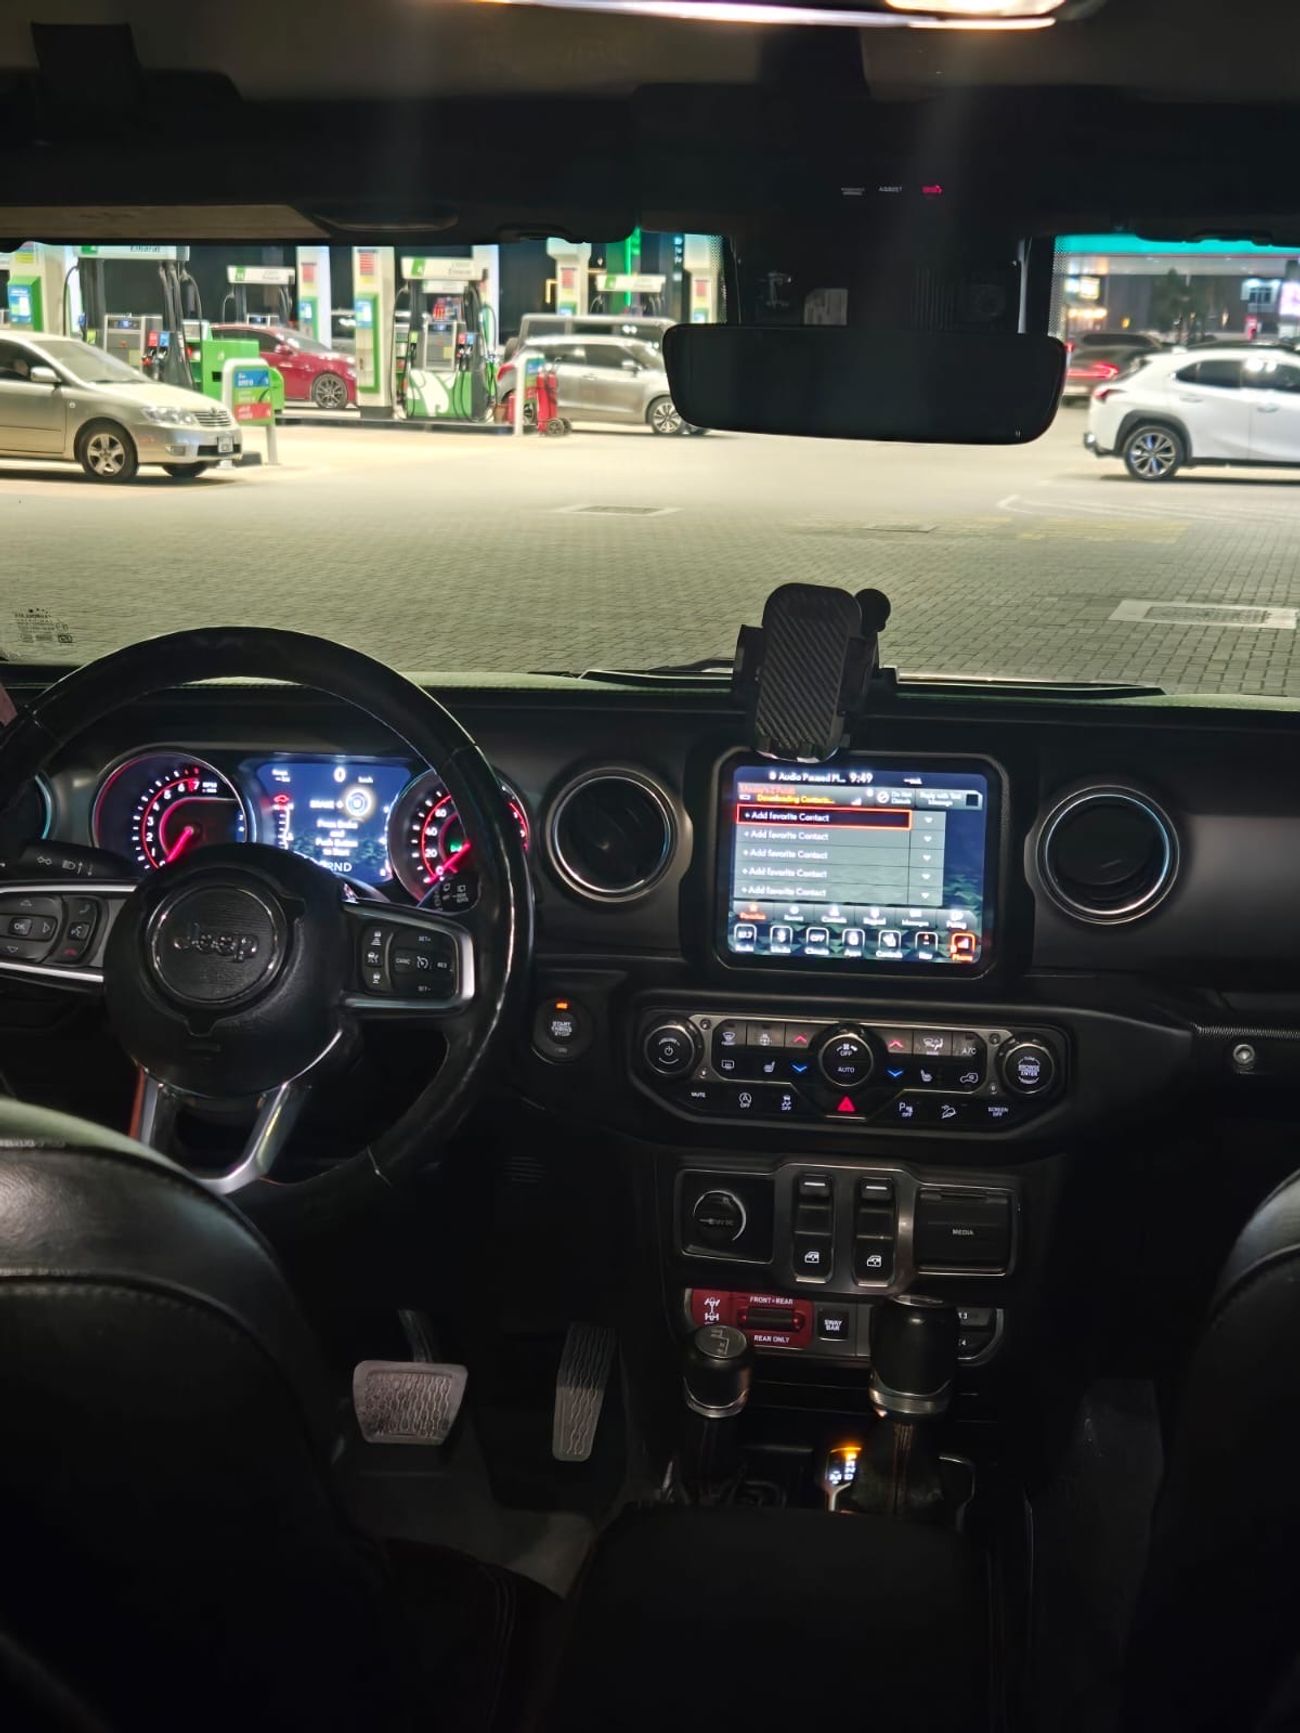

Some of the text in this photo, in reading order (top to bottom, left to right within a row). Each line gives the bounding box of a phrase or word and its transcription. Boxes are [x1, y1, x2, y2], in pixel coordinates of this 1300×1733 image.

[333, 767, 346, 783] 0
[778, 771, 801, 781] Audio
[849, 772, 873, 784] 9:49
[177, 783, 185, 792] 6
[147, 816, 154, 826] 3
[751, 811, 830, 822] Add favorite Contact
[146, 832, 153, 842] 2
[750, 829, 829, 841] Add favorite Contact
[424, 848, 438, 858] 20
[750, 848, 828, 859] Add favorite Contact
[748, 866, 766, 876] Add
[796, 868, 828, 878] Contact
[747, 885, 766, 895] Add
[796, 887, 827, 897] Contact
[962, 1047, 976, 1055] A/C
[952, 1227, 974, 1236] MEDIA
[824, 1319, 844, 1327] SWAY
[753, 1334, 790, 1344] REAR ONLY
